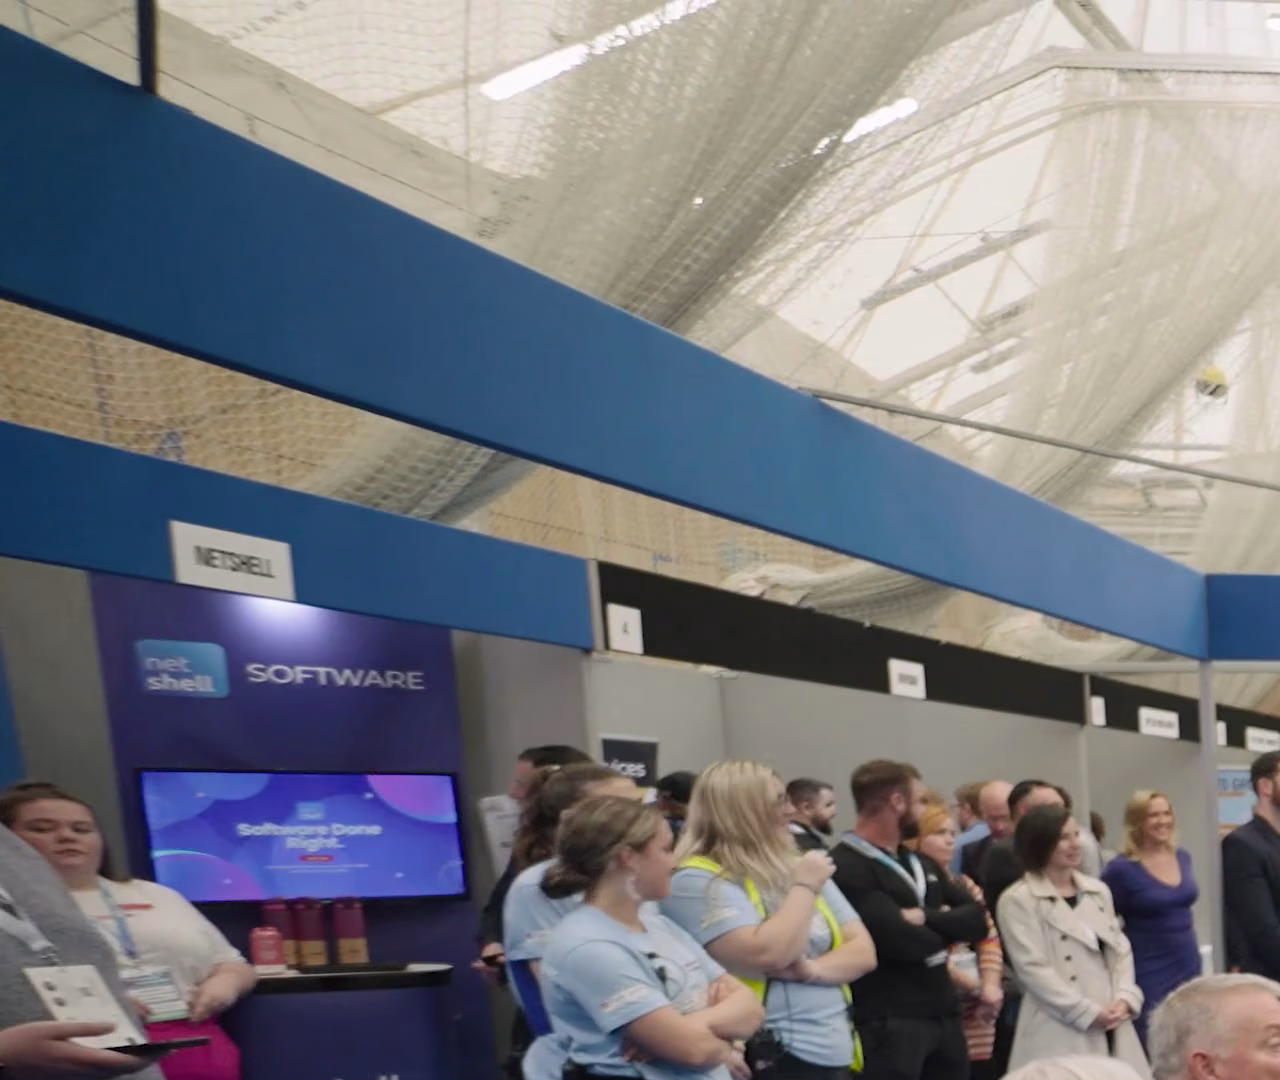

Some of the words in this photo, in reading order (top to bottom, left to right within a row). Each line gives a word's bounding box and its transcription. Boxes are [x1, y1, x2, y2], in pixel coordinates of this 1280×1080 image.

[193, 546, 275, 579] NETSHELL
[144, 656, 192, 673] net
[145, 674, 214, 693] shell
[246, 664, 425, 690] SOFTWARE
[238, 824, 329, 835] Software
[331, 824, 383, 835] Done
[287, 837, 345, 851] Right.
